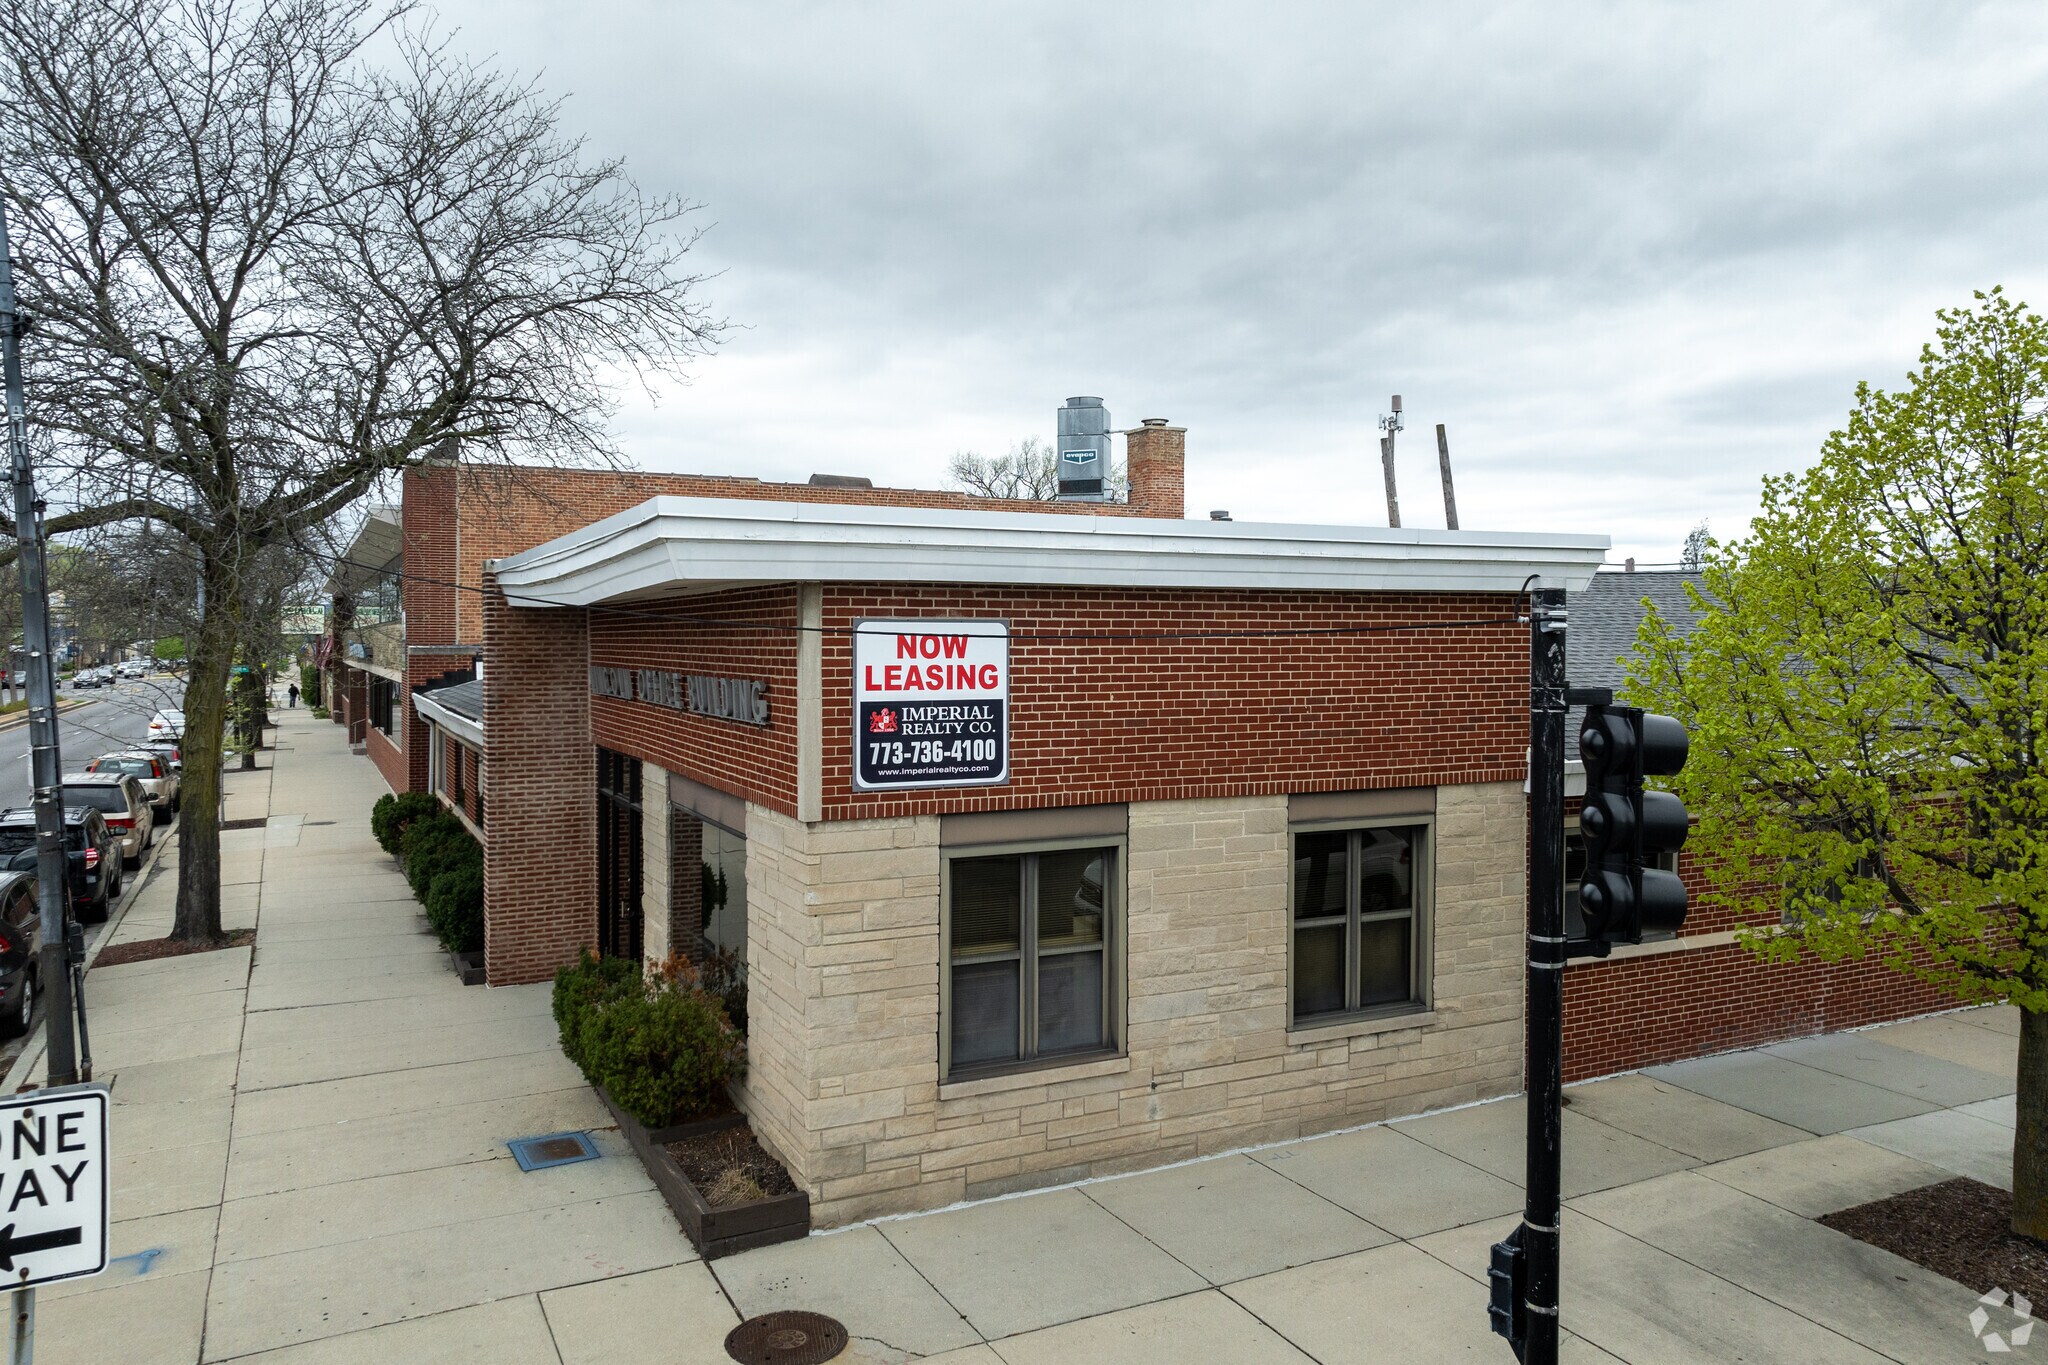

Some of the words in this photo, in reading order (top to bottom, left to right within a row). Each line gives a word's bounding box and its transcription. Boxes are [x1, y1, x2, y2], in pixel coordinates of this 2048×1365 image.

[897, 634, 969, 659] NOW
[865, 664, 999, 691] LEASING
[637, 668, 685, 709] OFFICE
[687, 675, 768, 725] BUILDING
[901, 705, 994, 722] IMPERIAL
[901, 722, 965, 735] REALTY
[969, 721, 996, 734] CO.
[869, 738, 996, 765] 773-736-4100
[878, 764, 990, 776] www.imperialrealtyco.com
[0, 1111, 86, 1160] NE
[0, 1160, 90, 1212] AY
